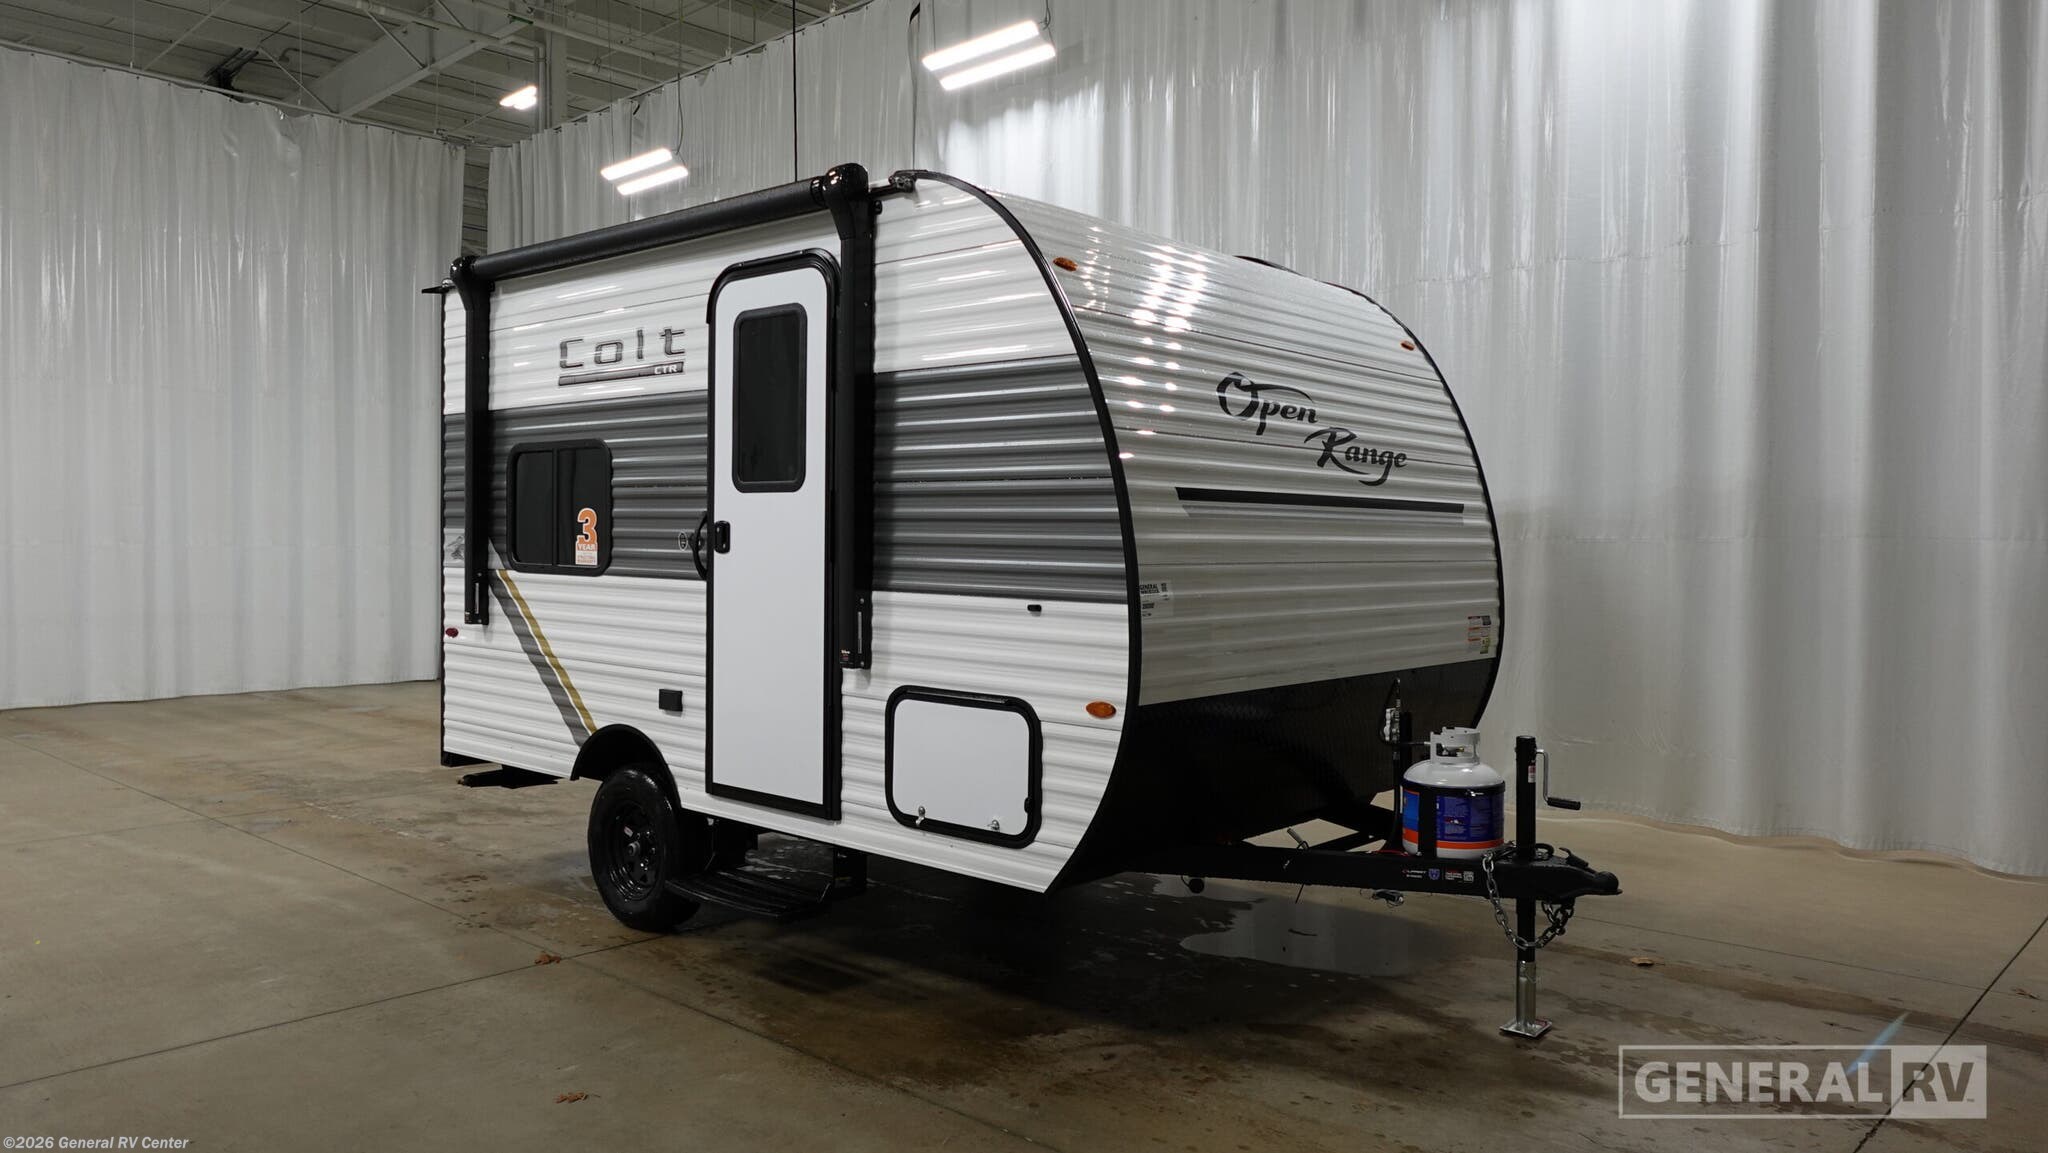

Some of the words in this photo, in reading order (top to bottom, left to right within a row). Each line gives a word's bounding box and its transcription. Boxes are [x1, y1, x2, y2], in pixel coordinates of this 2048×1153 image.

[559, 327, 685, 369] Colt
[654, 364, 678, 375] CTR
[1216, 371, 1318, 436] Open
[1303, 426, 1408, 487] Range
[577, 507, 597, 544] 3
[577, 543, 597, 551] YEAR
